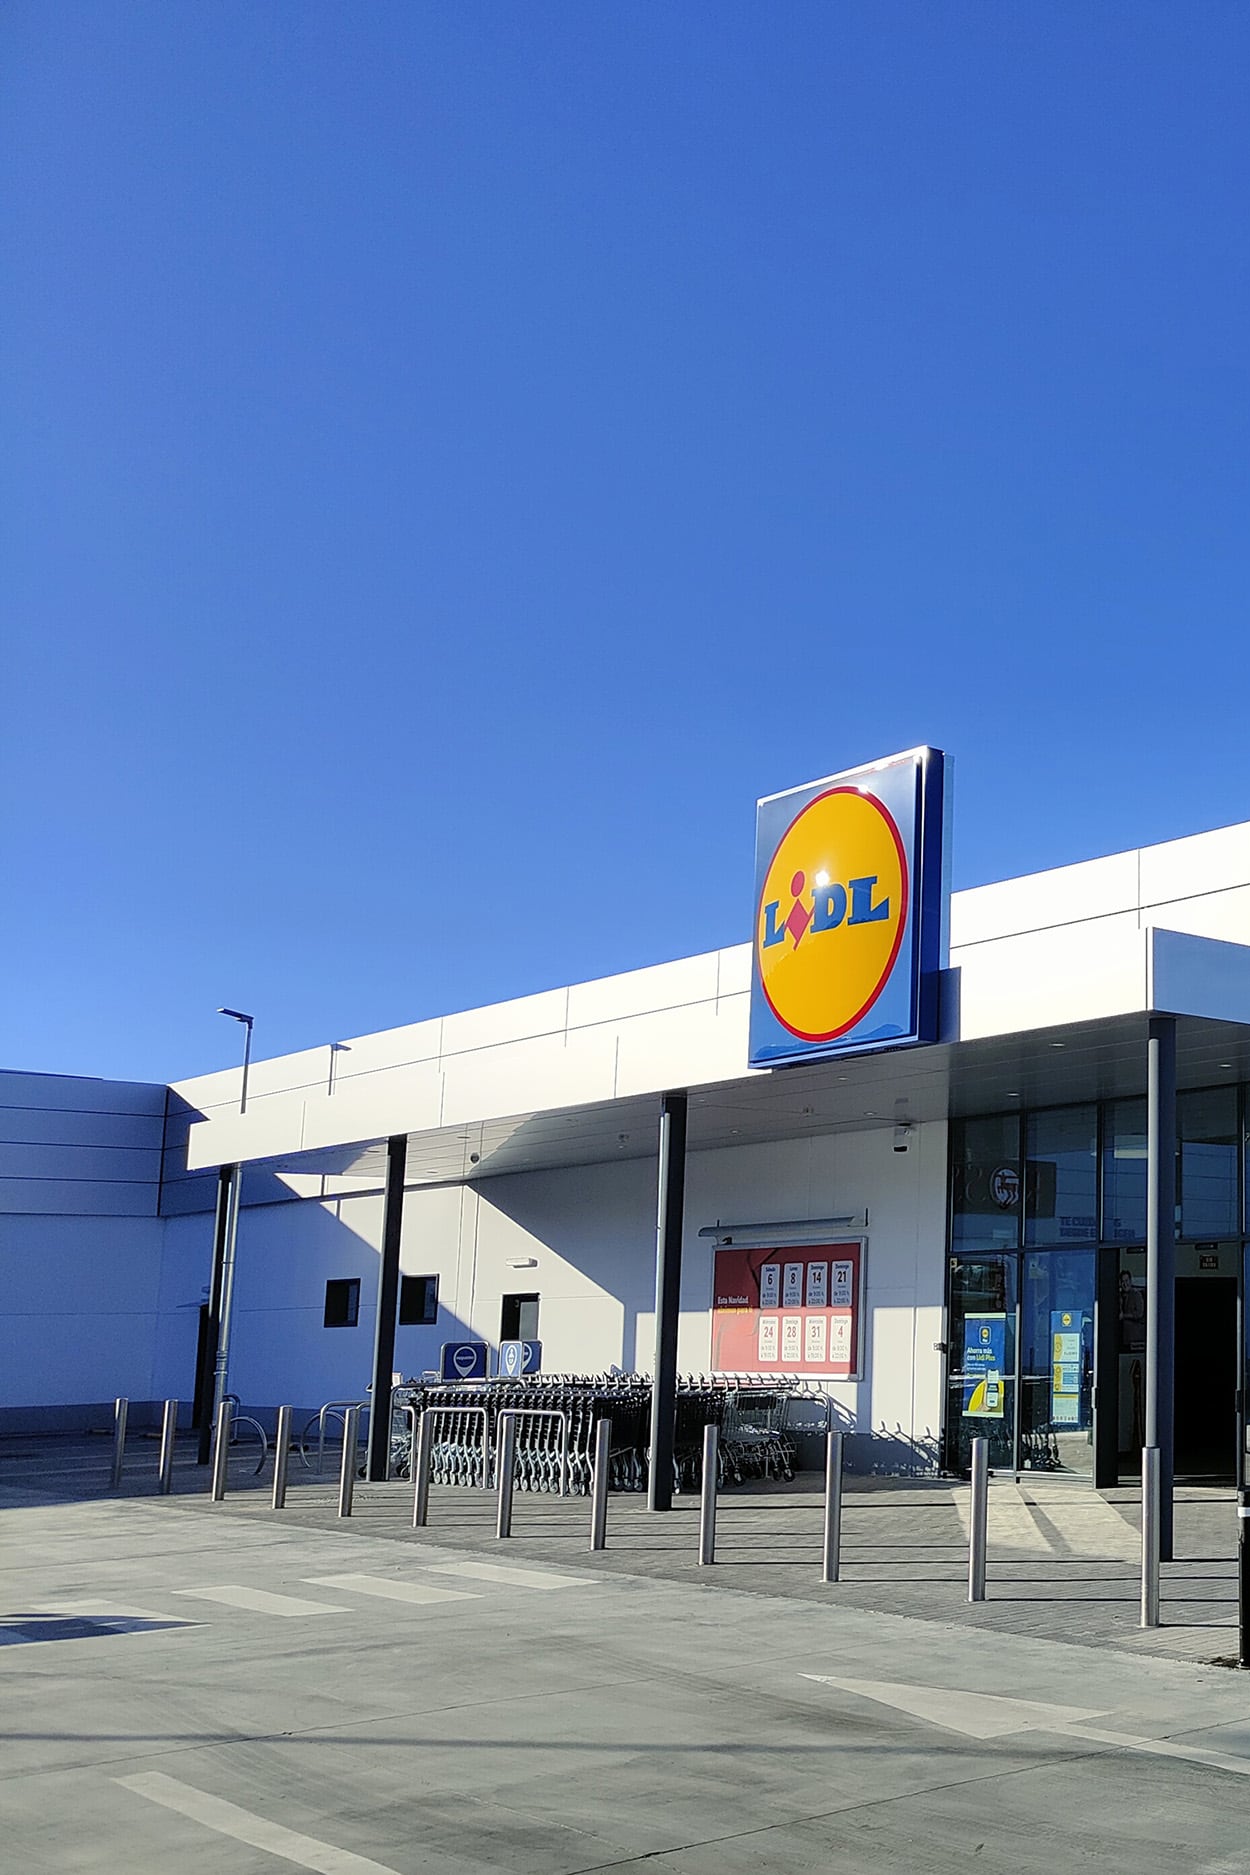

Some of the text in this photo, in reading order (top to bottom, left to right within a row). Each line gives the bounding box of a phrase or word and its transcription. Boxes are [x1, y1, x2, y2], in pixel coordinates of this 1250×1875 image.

[767, 1273, 773, 1285] 6
[790, 1272, 796, 1284] 8
[812, 1271, 821, 1283] 14
[837, 1270, 846, 1282] 21
[764, 1326, 774, 1338] 24
[787, 1326, 797, 1338] 28
[811, 1325, 820, 1338] 31
[837, 1325, 843, 1338] 4
